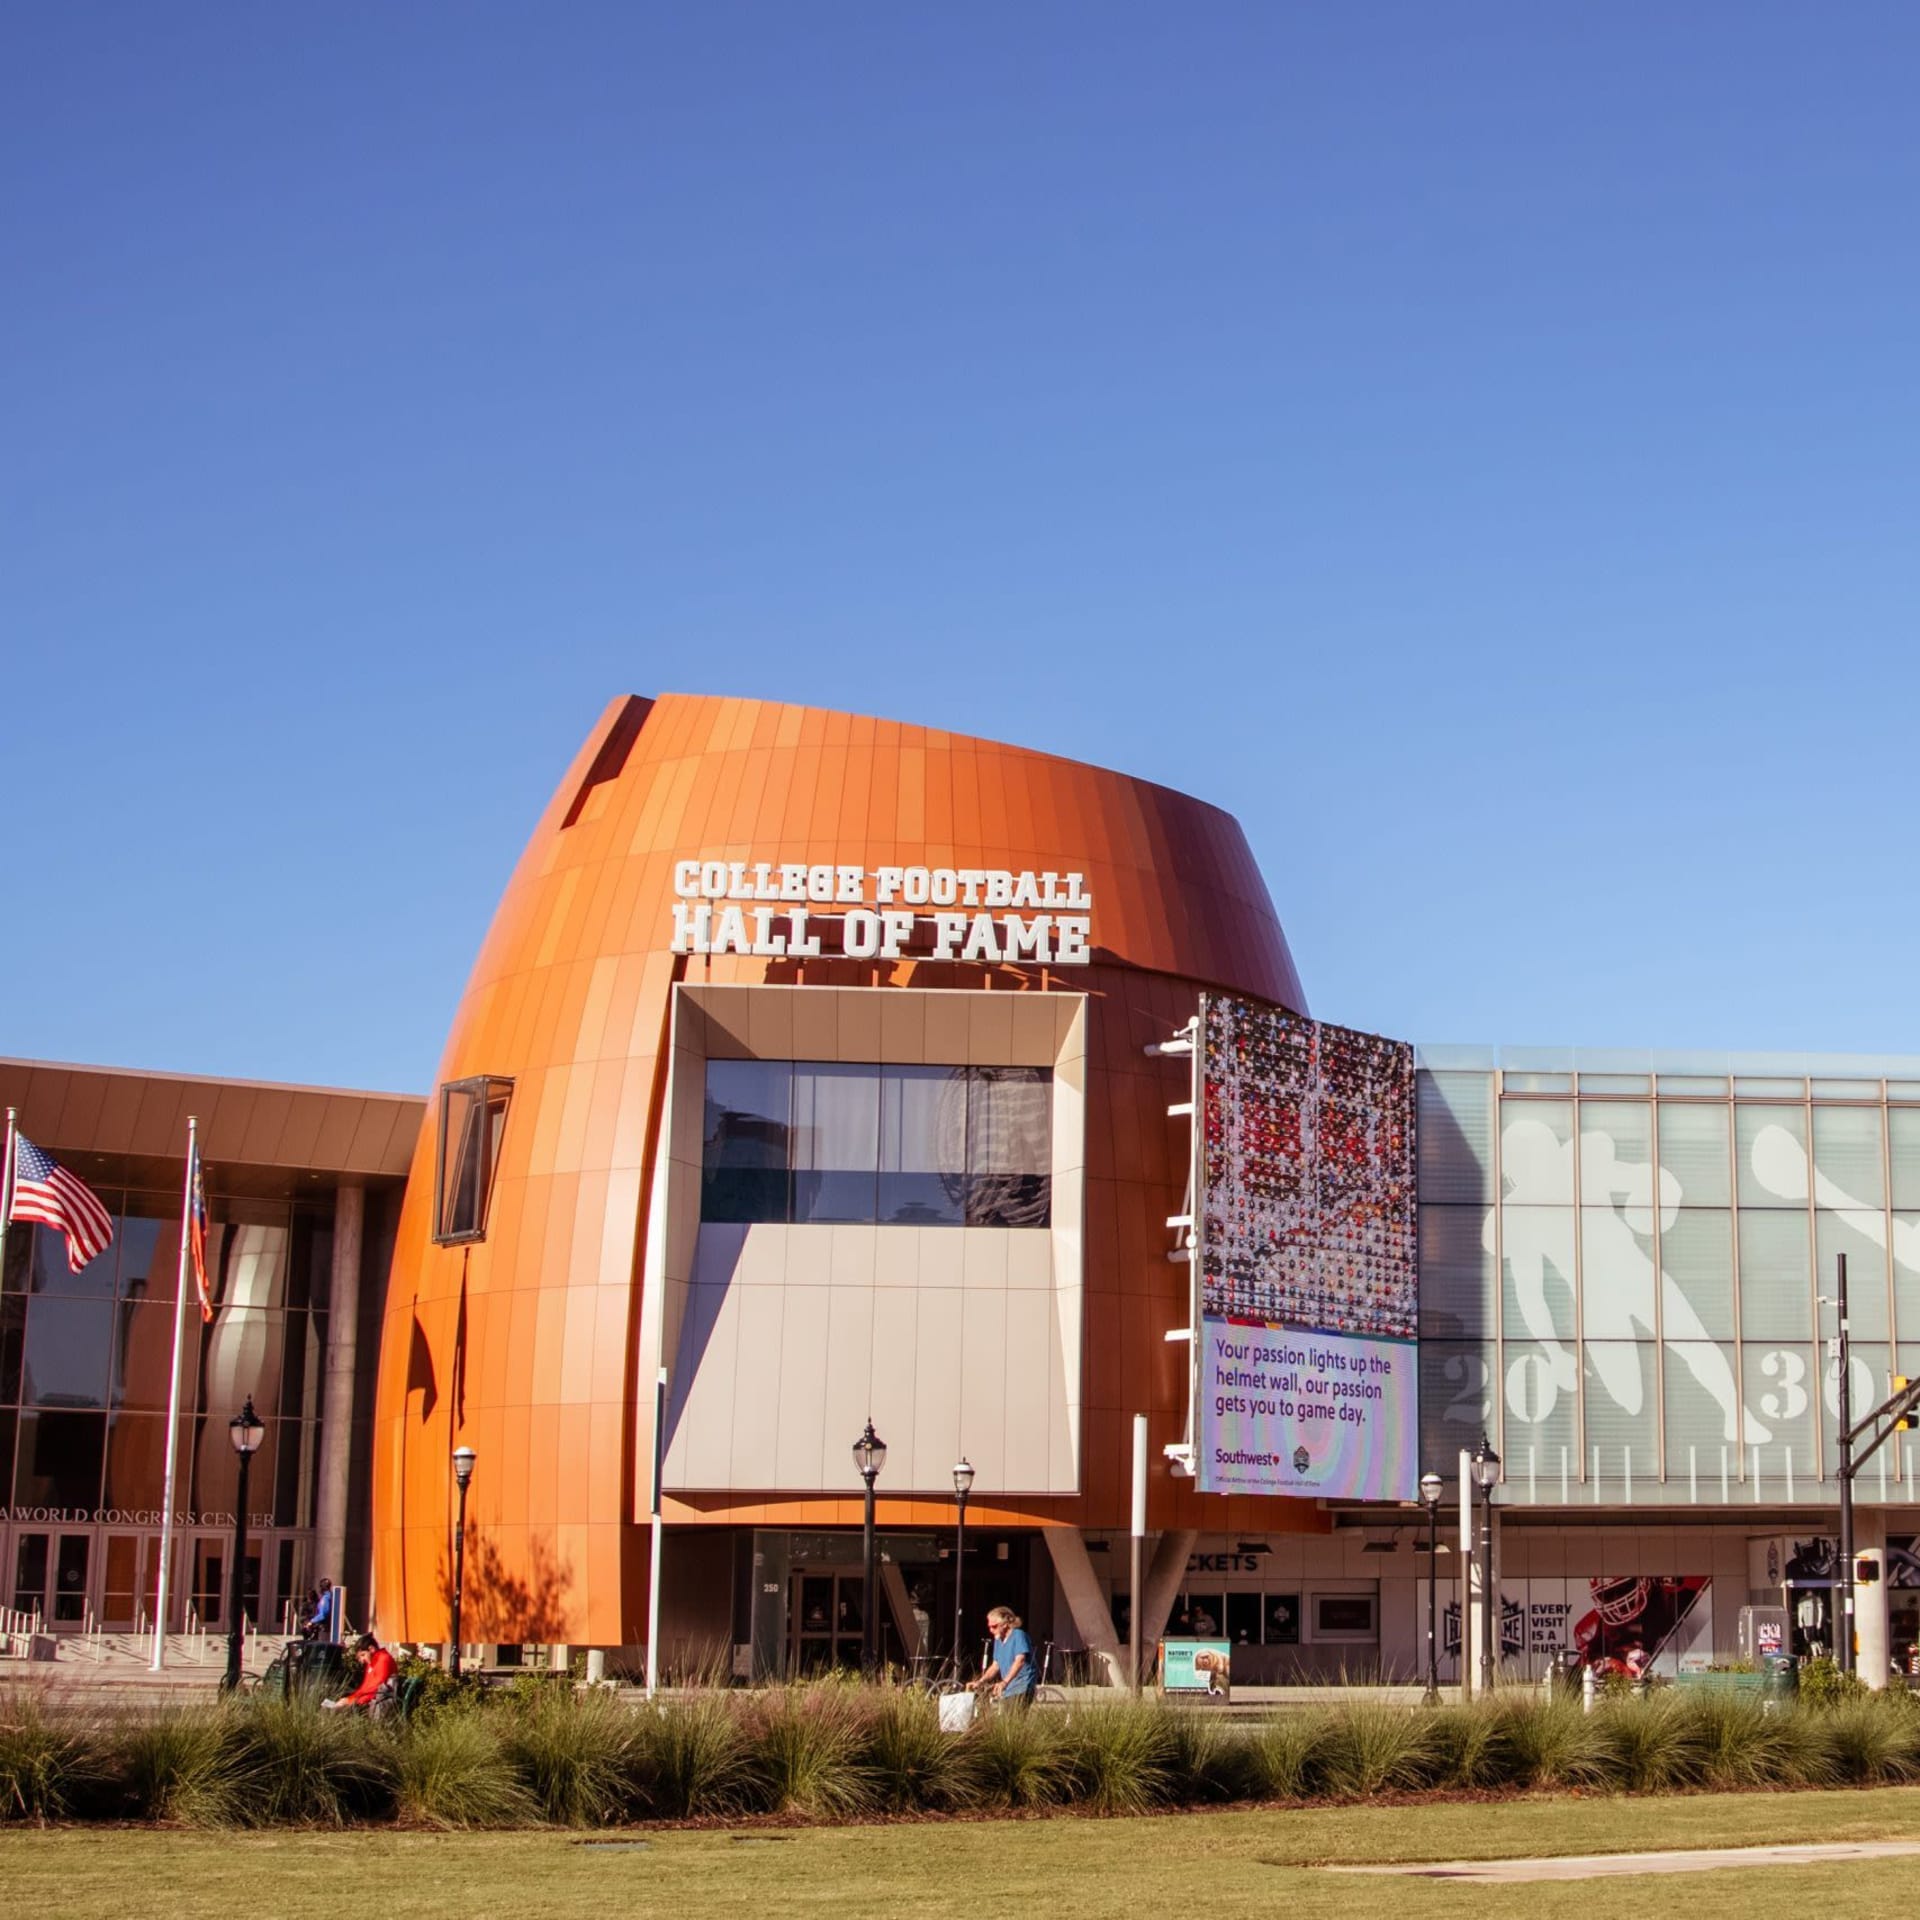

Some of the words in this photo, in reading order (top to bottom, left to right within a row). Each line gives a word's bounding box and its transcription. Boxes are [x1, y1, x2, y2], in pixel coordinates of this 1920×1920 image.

[674, 860, 865, 902] COLLEGE
[876, 866, 1092, 909] FOOTBALL
[670, 904, 821, 957] HALL
[843, 909, 914, 959] OF
[932, 912, 1091, 965] FAME
[1216, 1338, 1250, 1360] Your
[1252, 1345, 1306, 1366] passion
[1309, 1347, 1347, 1373] lights
[1350, 1359, 1367, 1377] up
[1370, 1354, 1392, 1375] the
[1216, 1365, 1266, 1389] helmet
[1270, 1372, 1302, 1396] wall,
[1305, 1379, 1330, 1395] our
[1332, 1379, 1383, 1401] passion
[1216, 1395, 1247, 1417] gets
[1250, 1401, 1276, 1418] you
[1280, 1399, 1294, 1416] to
[1297, 1404, 1336, 1422] game
[1339, 1402, 1367, 1427] day.
[1215, 1448, 1273, 1467] Southwest
[15, 1506, 89, 1523] WORLD
[93, 1508, 196, 1527] CONGRSS
[201, 1511, 275, 1528] CENER
[1185, 1554, 1258, 1571] CKETS
[1531, 1604, 1573, 1615] EVERY
[1531, 1617, 1564, 1628] VISIT
[1531, 1630, 1544, 1641] IS
[1547, 1630, 1557, 1641] A
[1531, 1643, 1567, 1654] RUSH
